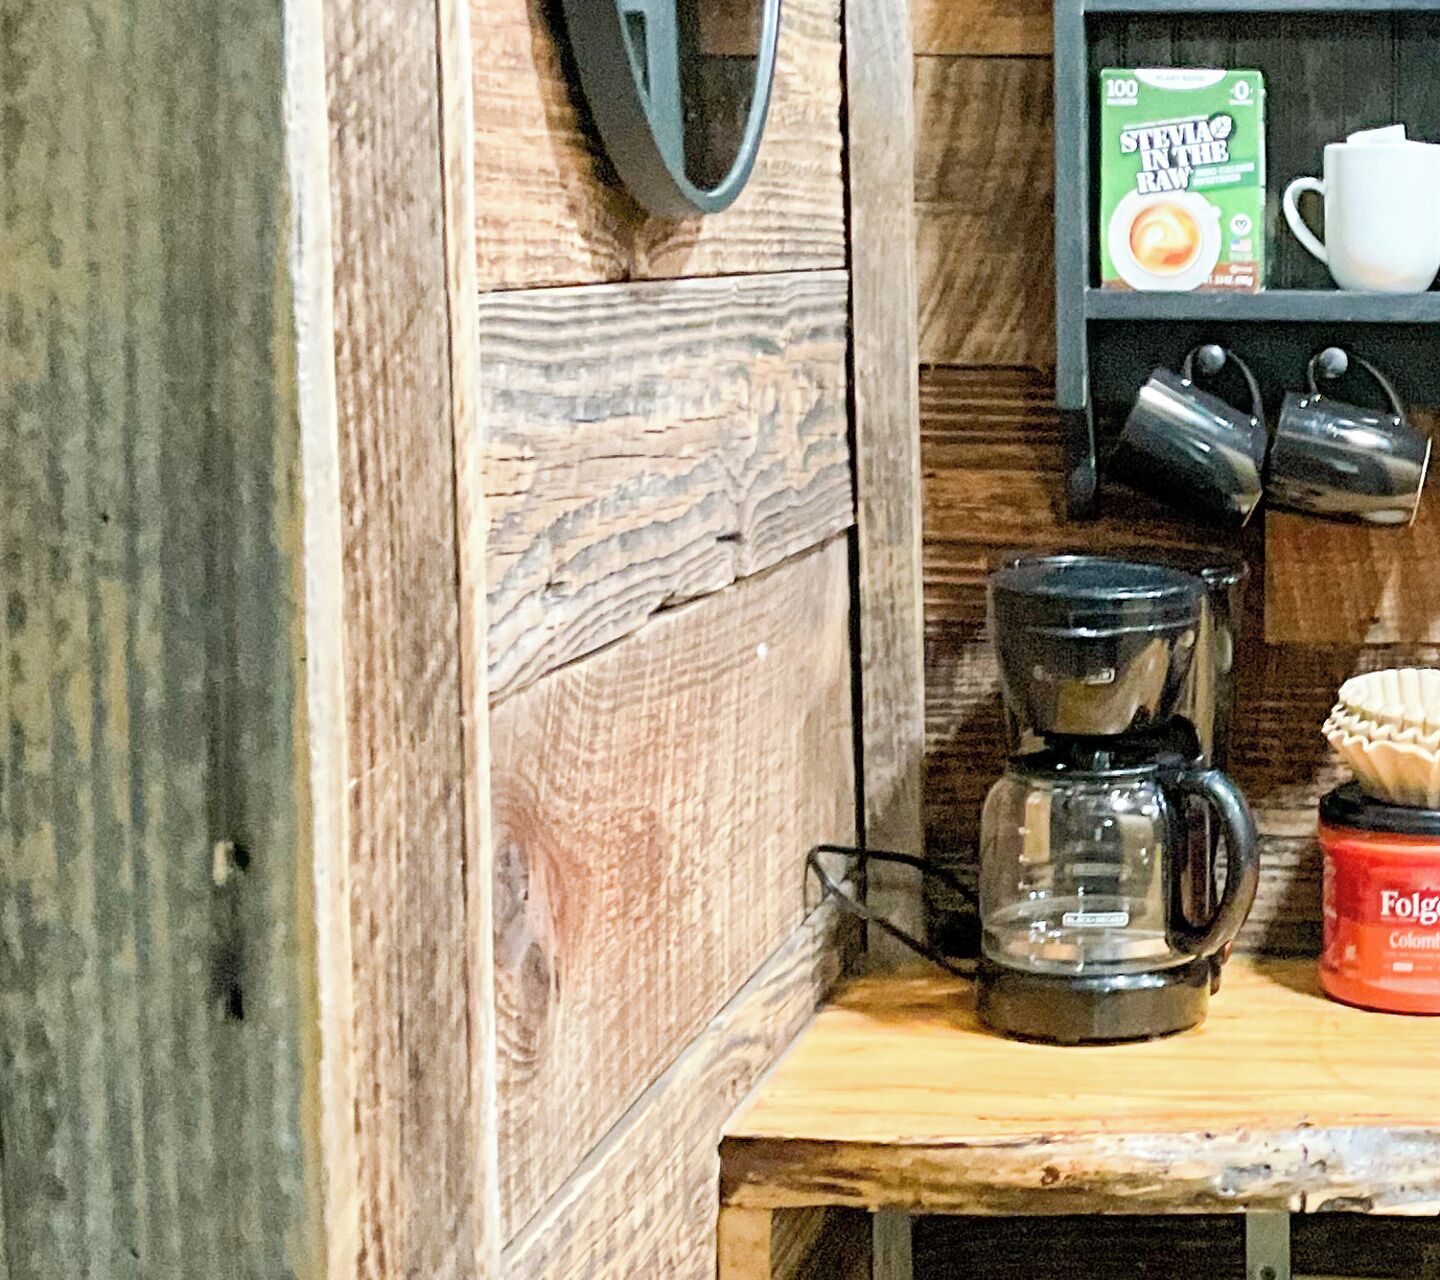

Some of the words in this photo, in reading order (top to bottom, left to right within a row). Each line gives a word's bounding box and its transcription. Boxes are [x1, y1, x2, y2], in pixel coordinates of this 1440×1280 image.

[1106, 79, 1139, 98] 100
[1234, 80, 1250, 100] 0
[1120, 120, 1214, 154] STEVIA
[1140, 147, 1171, 172] IN
[1171, 139, 1231, 167] THE
[1136, 166, 1193, 194] RAW
